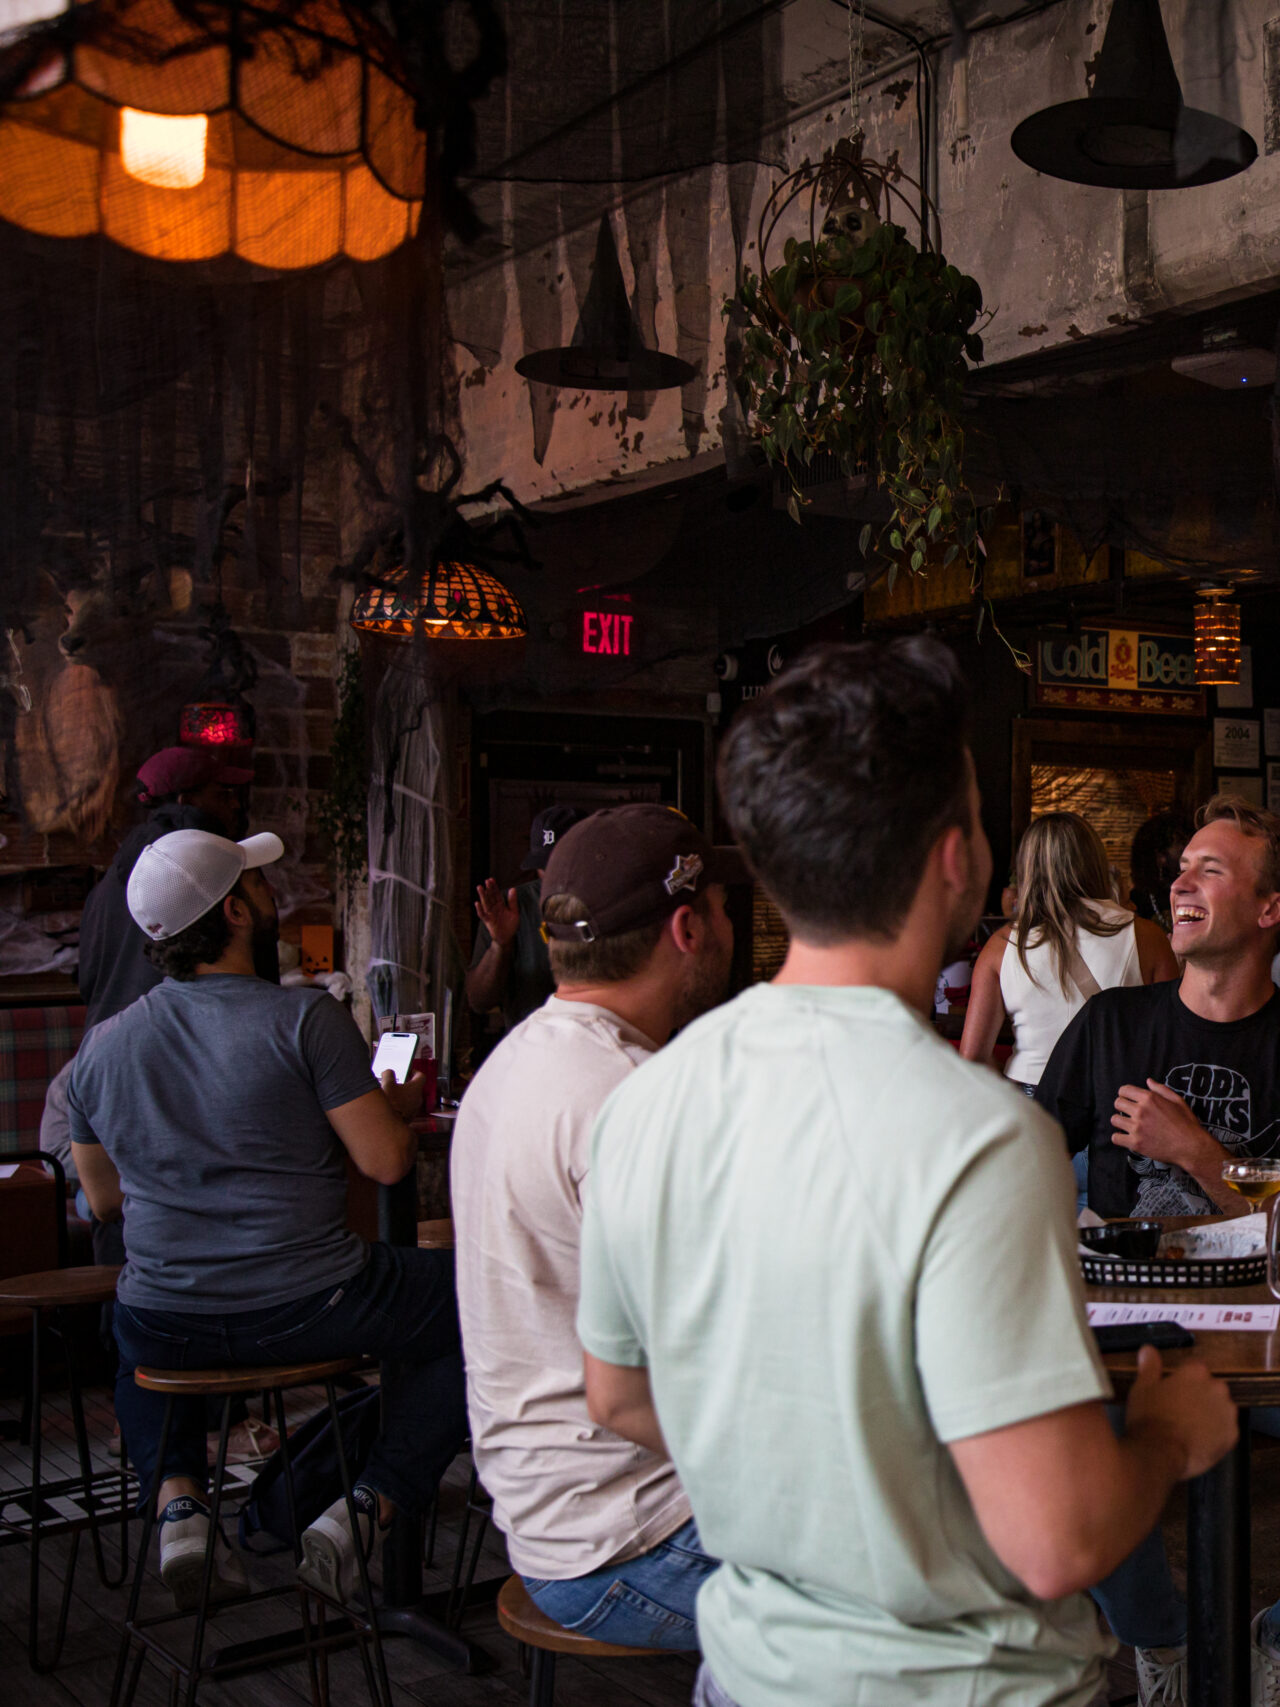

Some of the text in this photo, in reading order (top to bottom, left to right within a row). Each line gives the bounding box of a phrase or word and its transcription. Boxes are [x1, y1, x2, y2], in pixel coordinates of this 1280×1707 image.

[582, 611, 634, 656] EXIT
[1042, 634, 1197, 686] Cold Bee
[1225, 726, 1250, 739] 2004
[542, 829, 555, 847] D
[166, 1500, 193, 1516] NIKE
[352, 1487, 373, 1510] NIKE
